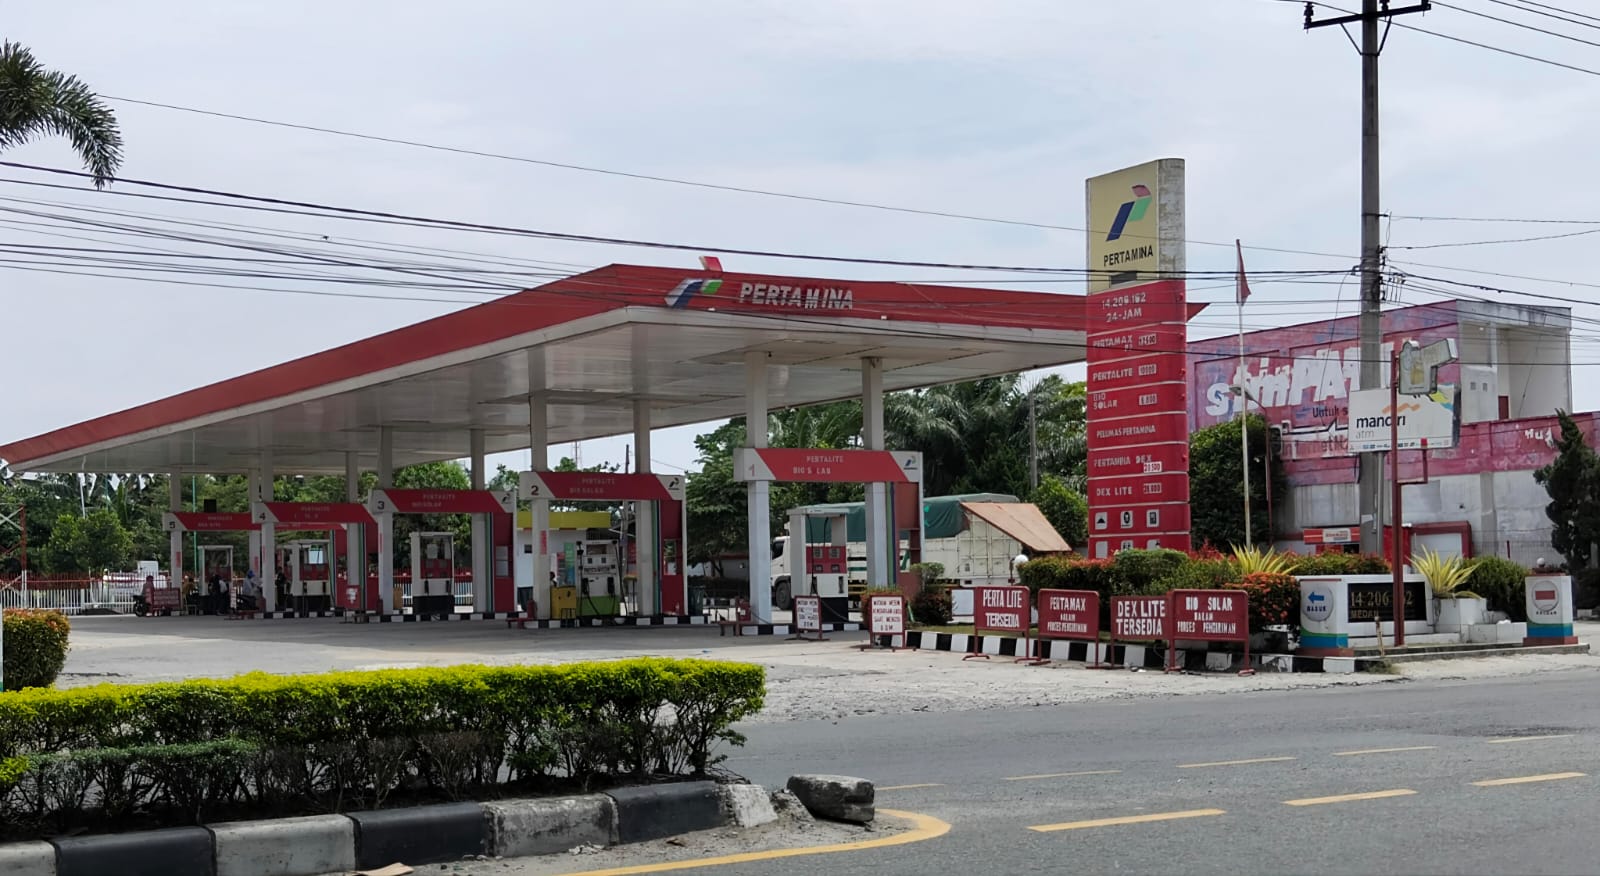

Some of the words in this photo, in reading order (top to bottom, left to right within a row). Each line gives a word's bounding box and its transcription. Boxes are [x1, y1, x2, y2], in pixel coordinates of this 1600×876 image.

[1103, 245, 1154, 267] PERTAMINA
[739, 282, 854, 310] PERTAMINA
[1092, 368, 1133, 381] PERTALITE
[1356, 415, 1406, 429] mandri
[806, 455, 844, 463] PERTALITE
[530, 485, 539, 496] 2
[1096, 487, 1111, 496] DEX
[1114, 486, 1133, 495] LITE
[377, 501, 385, 510] 3
[259, 512, 266, 521] 4
[169, 521, 176, 529] 5
[1050, 597, 1087, 611] PERTAMAX
[1117, 601, 1137, 617] DEX
[1140, 600, 1166, 617] LITE
[1185, 597, 1199, 611] BIO
[1207, 597, 1233, 611] SOLAR
[985, 612, 1020, 628] TERSEDIA
[1116, 619, 1163, 636] TERSEDIA
